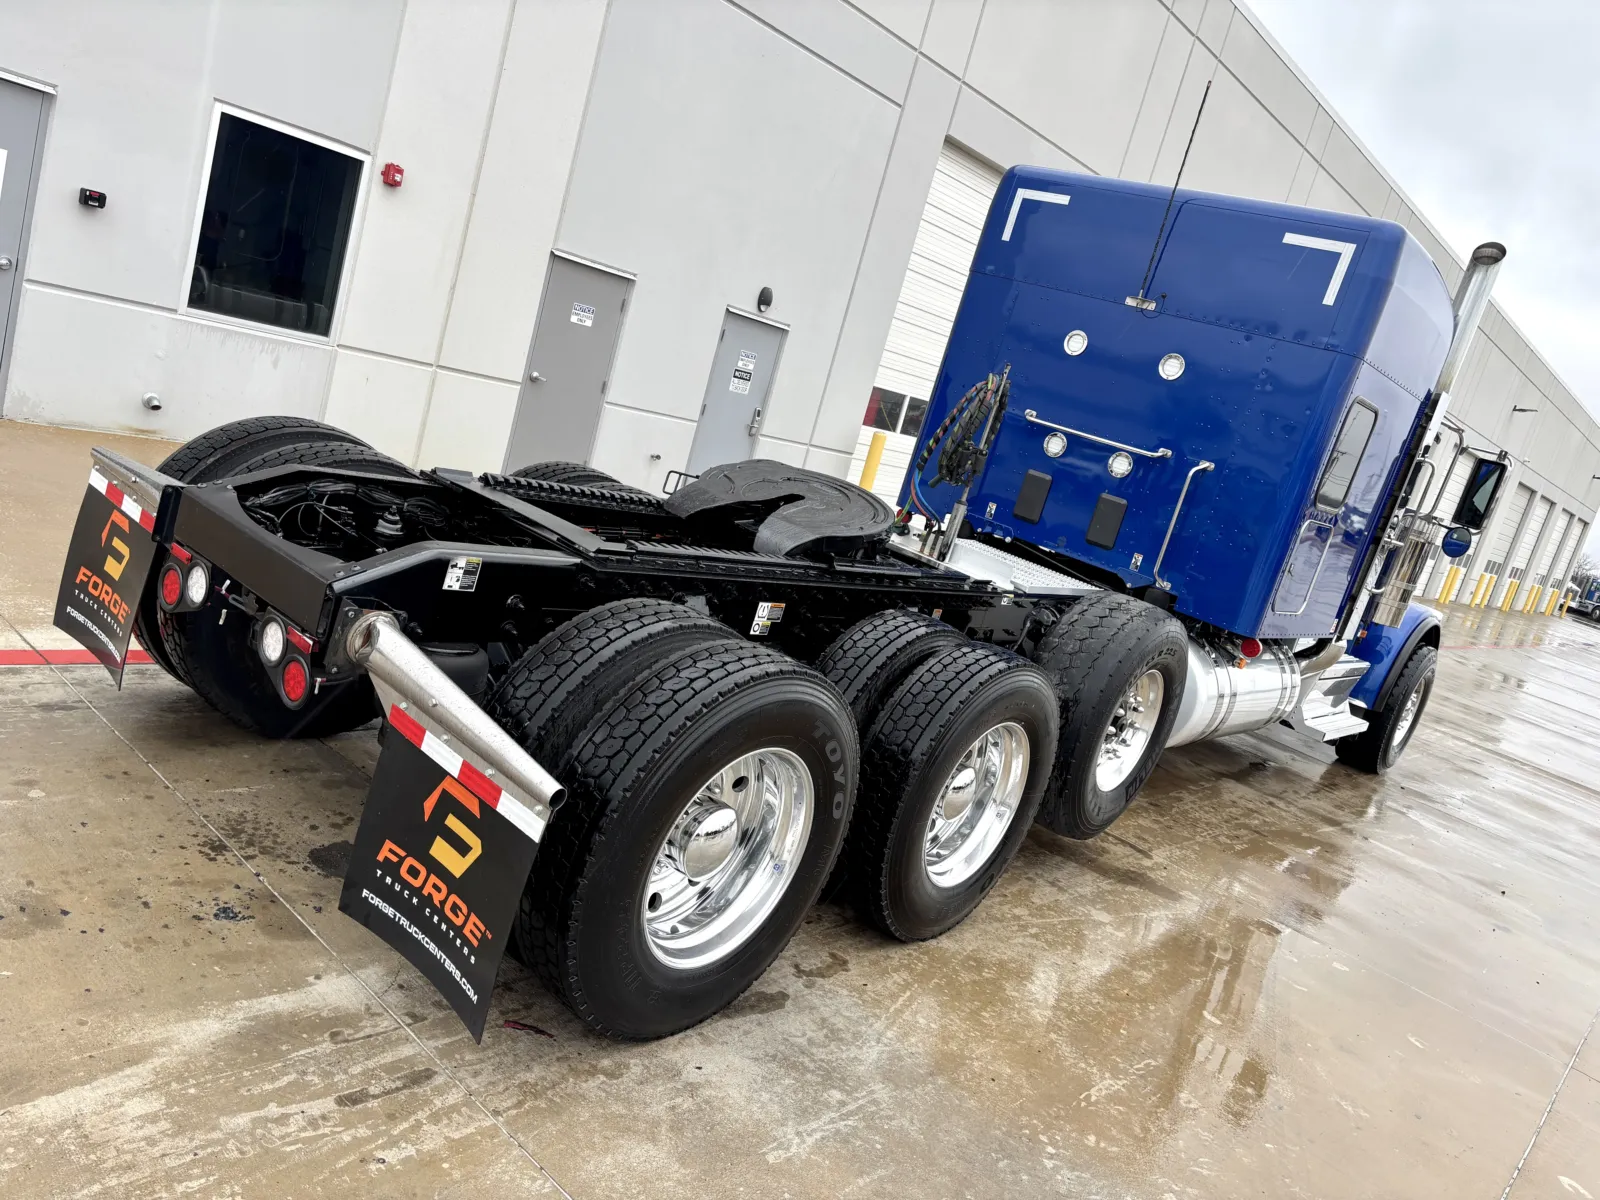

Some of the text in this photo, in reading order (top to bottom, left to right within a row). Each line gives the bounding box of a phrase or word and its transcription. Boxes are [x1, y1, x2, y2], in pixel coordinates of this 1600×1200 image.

[573, 304, 595, 315] NOTICE
[735, 371, 750, 379] NOTICE
[74, 589, 98, 611] TRUCK
[75, 566, 129, 625] FORGE
[811, 719, 846, 820] TOYO
[375, 868, 476, 965] TRUCK CENTERS
[376, 838, 486, 948] FORGE
[361, 888, 478, 1005] FORGETRUCKCENTERS.COM
